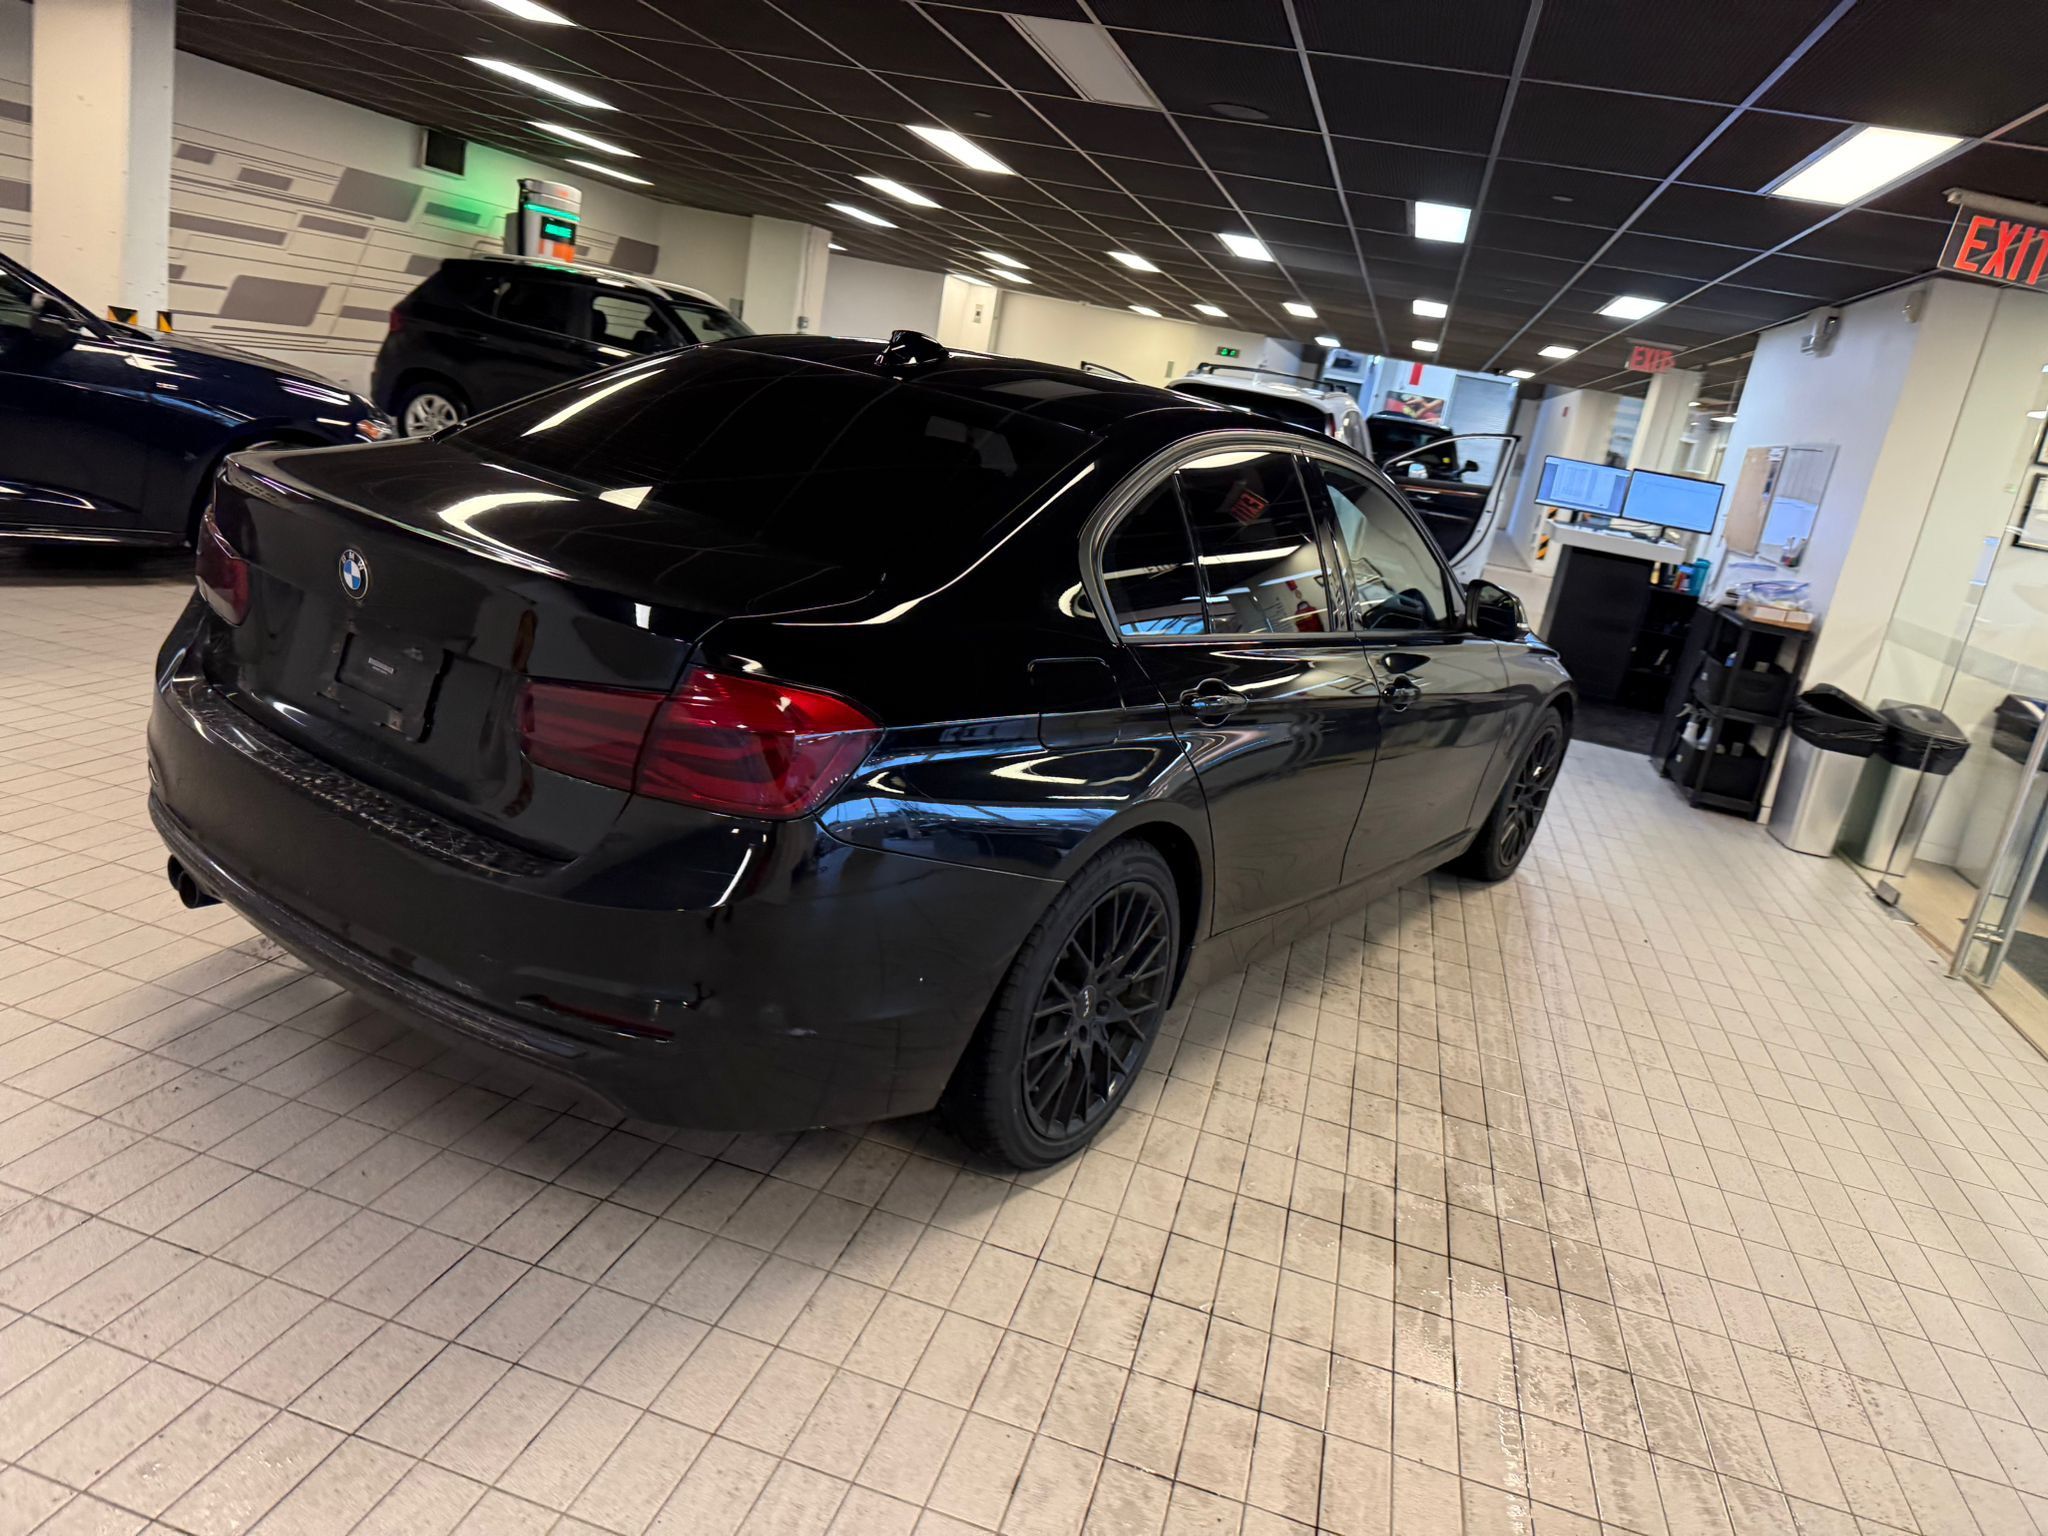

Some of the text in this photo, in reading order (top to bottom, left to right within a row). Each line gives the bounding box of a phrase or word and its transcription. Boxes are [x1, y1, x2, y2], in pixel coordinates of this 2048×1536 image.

[1953, 215, 2048, 286] EXIT
[1631, 345, 1673, 373] EXIT
[341, 551, 365, 571] BMW
